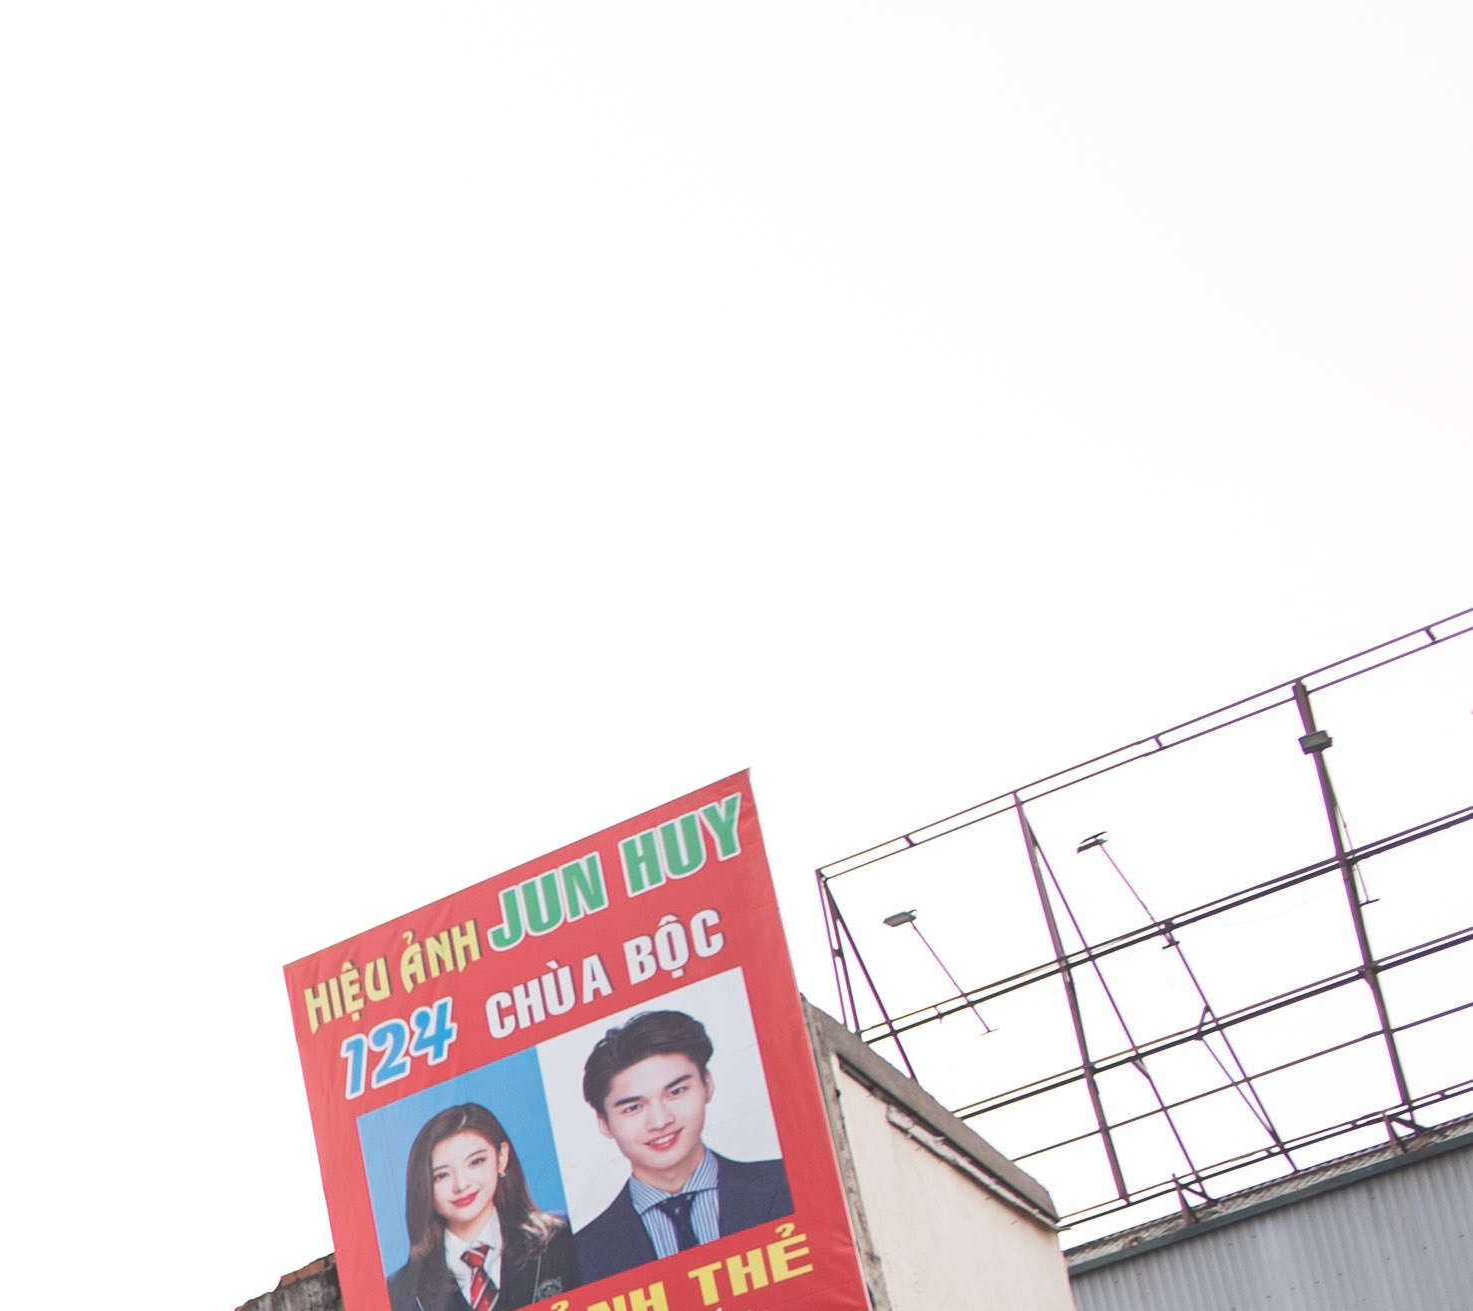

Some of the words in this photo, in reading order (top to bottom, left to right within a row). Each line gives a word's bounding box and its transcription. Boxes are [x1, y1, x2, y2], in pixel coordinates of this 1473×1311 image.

[304, 960, 390, 1033] HIỆU
[399, 919, 482, 994] ẢNH
[488, 855, 606, 953] JUN
[622, 793, 742, 897] HUY
[340, 997, 457, 1099] 124
[485, 955, 612, 1040] CHÙA
[625, 908, 724, 986] BỘC
[689, 1223, 812, 1303] THẺ
